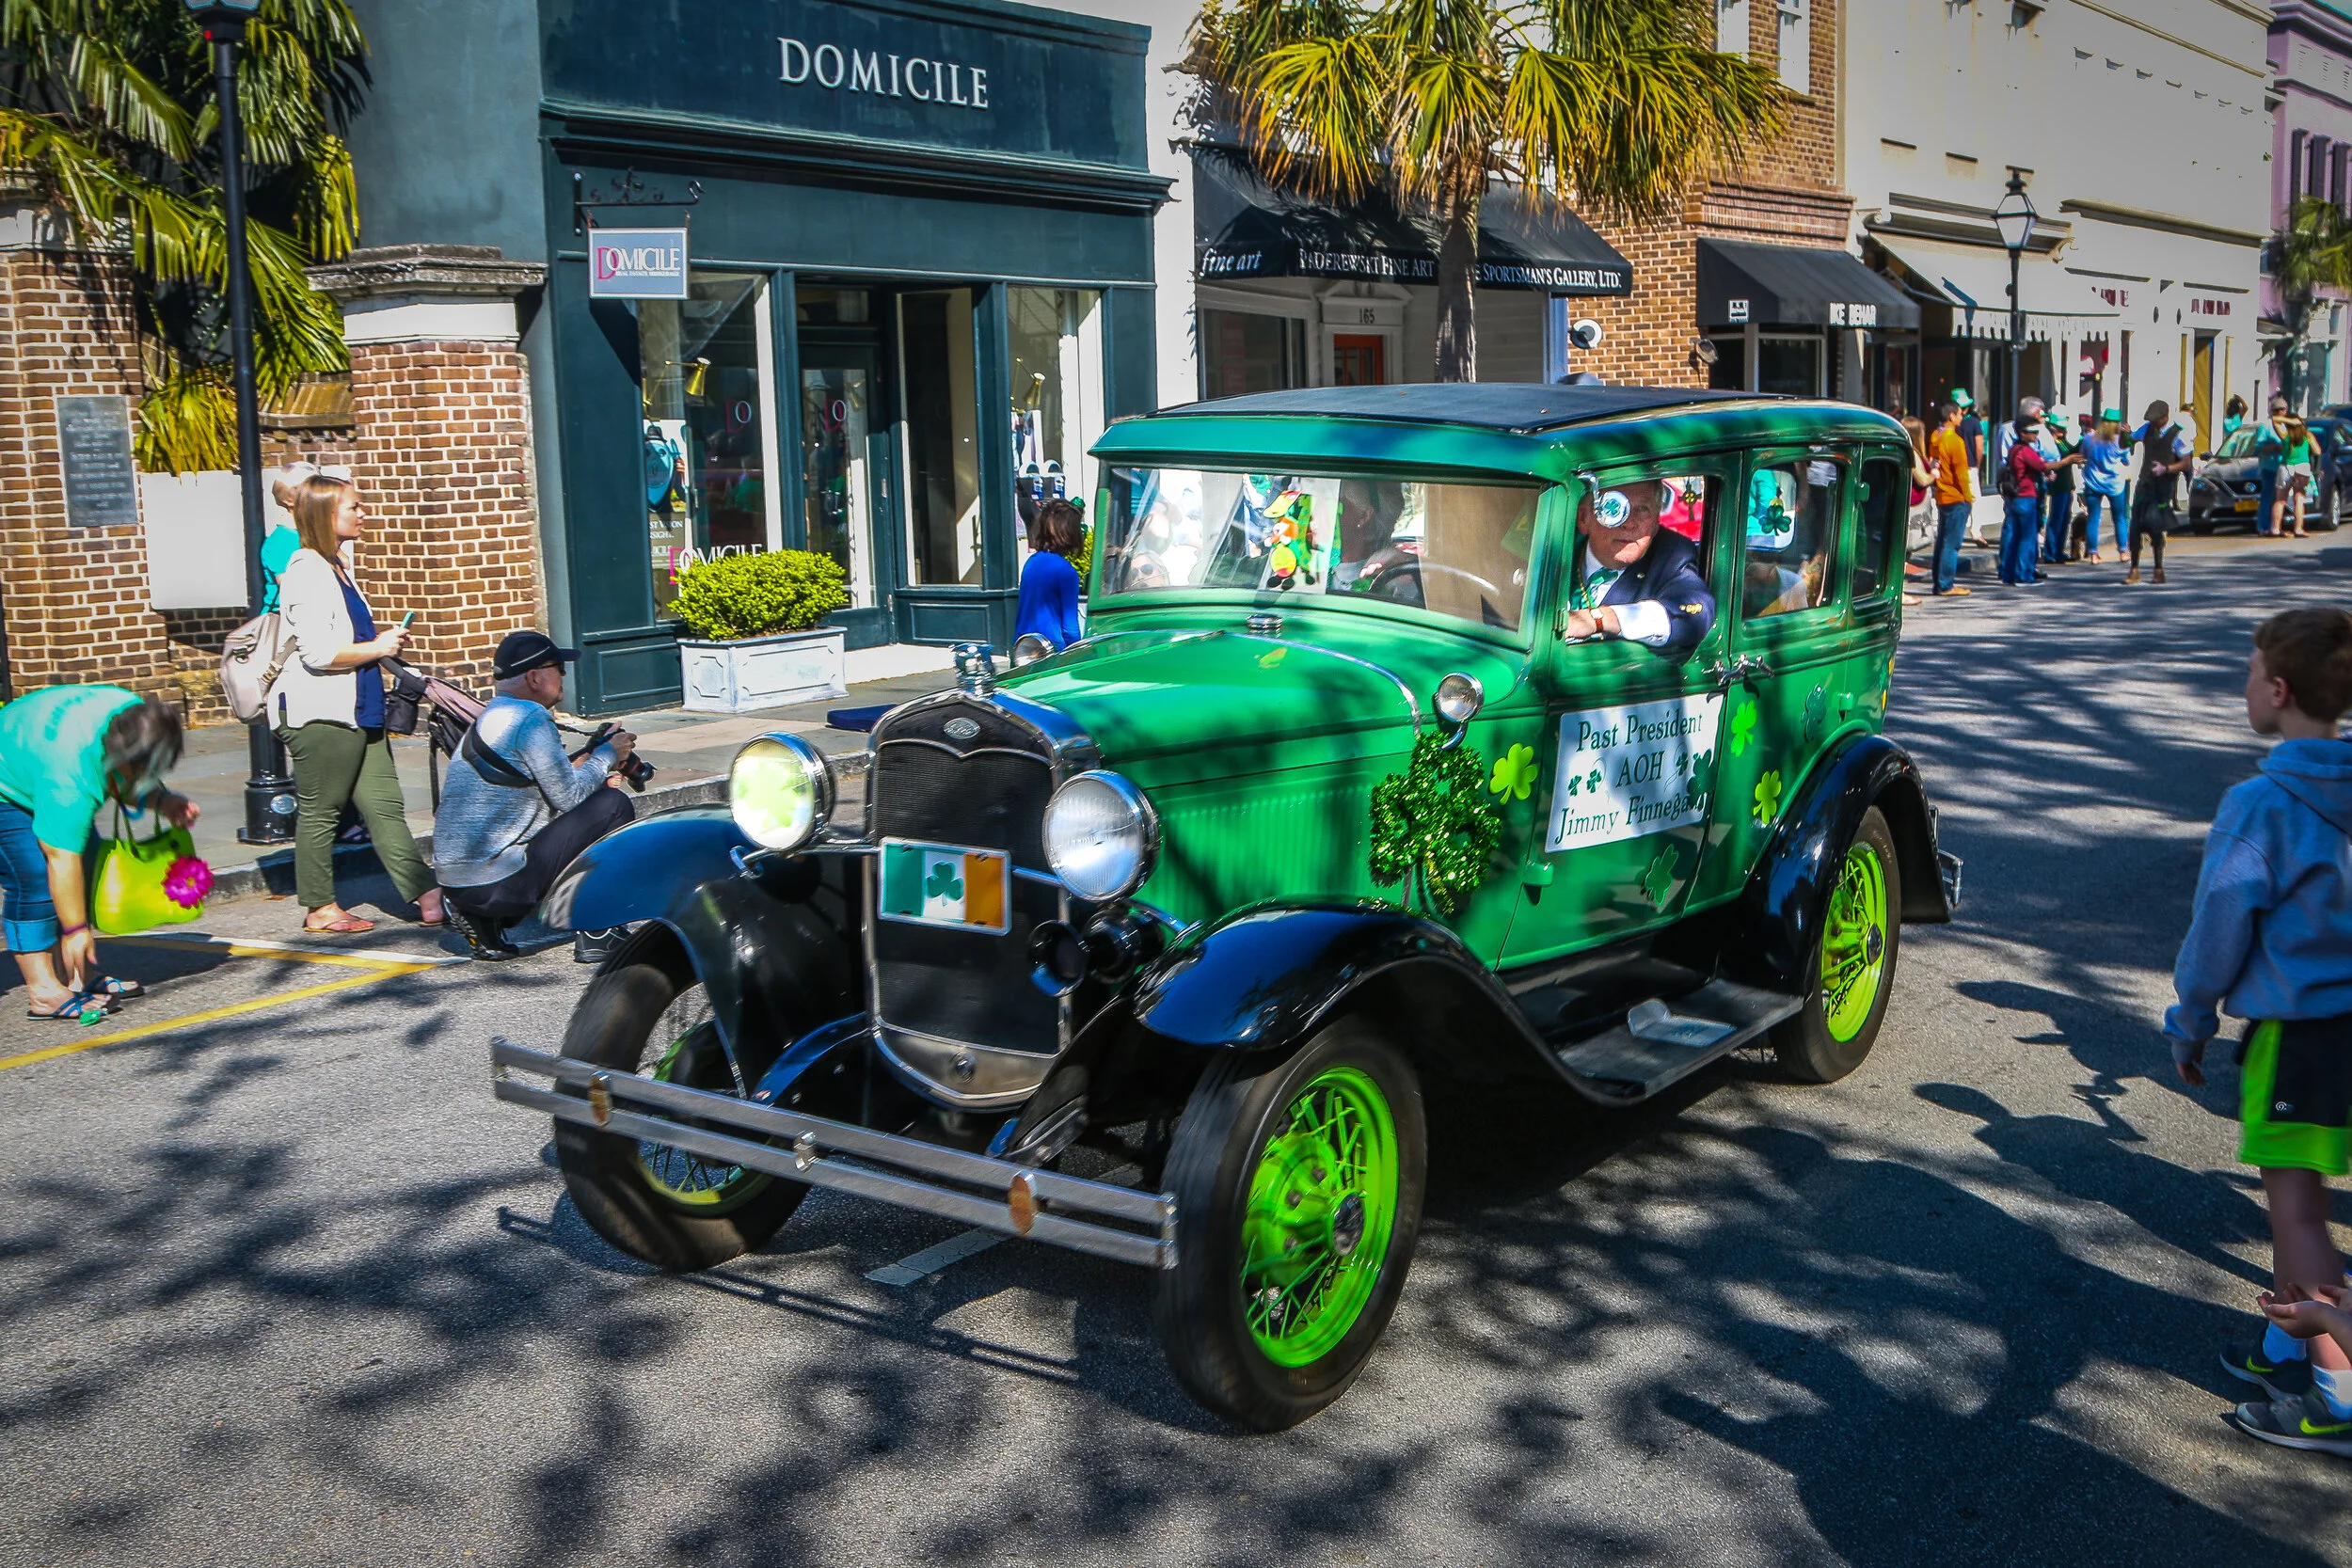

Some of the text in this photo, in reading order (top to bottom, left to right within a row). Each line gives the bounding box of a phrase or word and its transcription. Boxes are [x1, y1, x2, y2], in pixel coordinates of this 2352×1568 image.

[777, 37, 988, 108] DOMICILE
[596, 245, 680, 280] DOMICILE
[1199, 247, 1263, 277] fine art
[1380, 255, 1409, 277] FINE
[1411, 260, 1436, 277] ART
[1483, 262, 1552, 285] SPORTSMAN'S
[1359, 308, 1375, 325] 165
[1576, 708, 1703, 752] Past President
[1615, 750, 1665, 788] AOH
[1554, 807, 1620, 845] Jimmy
